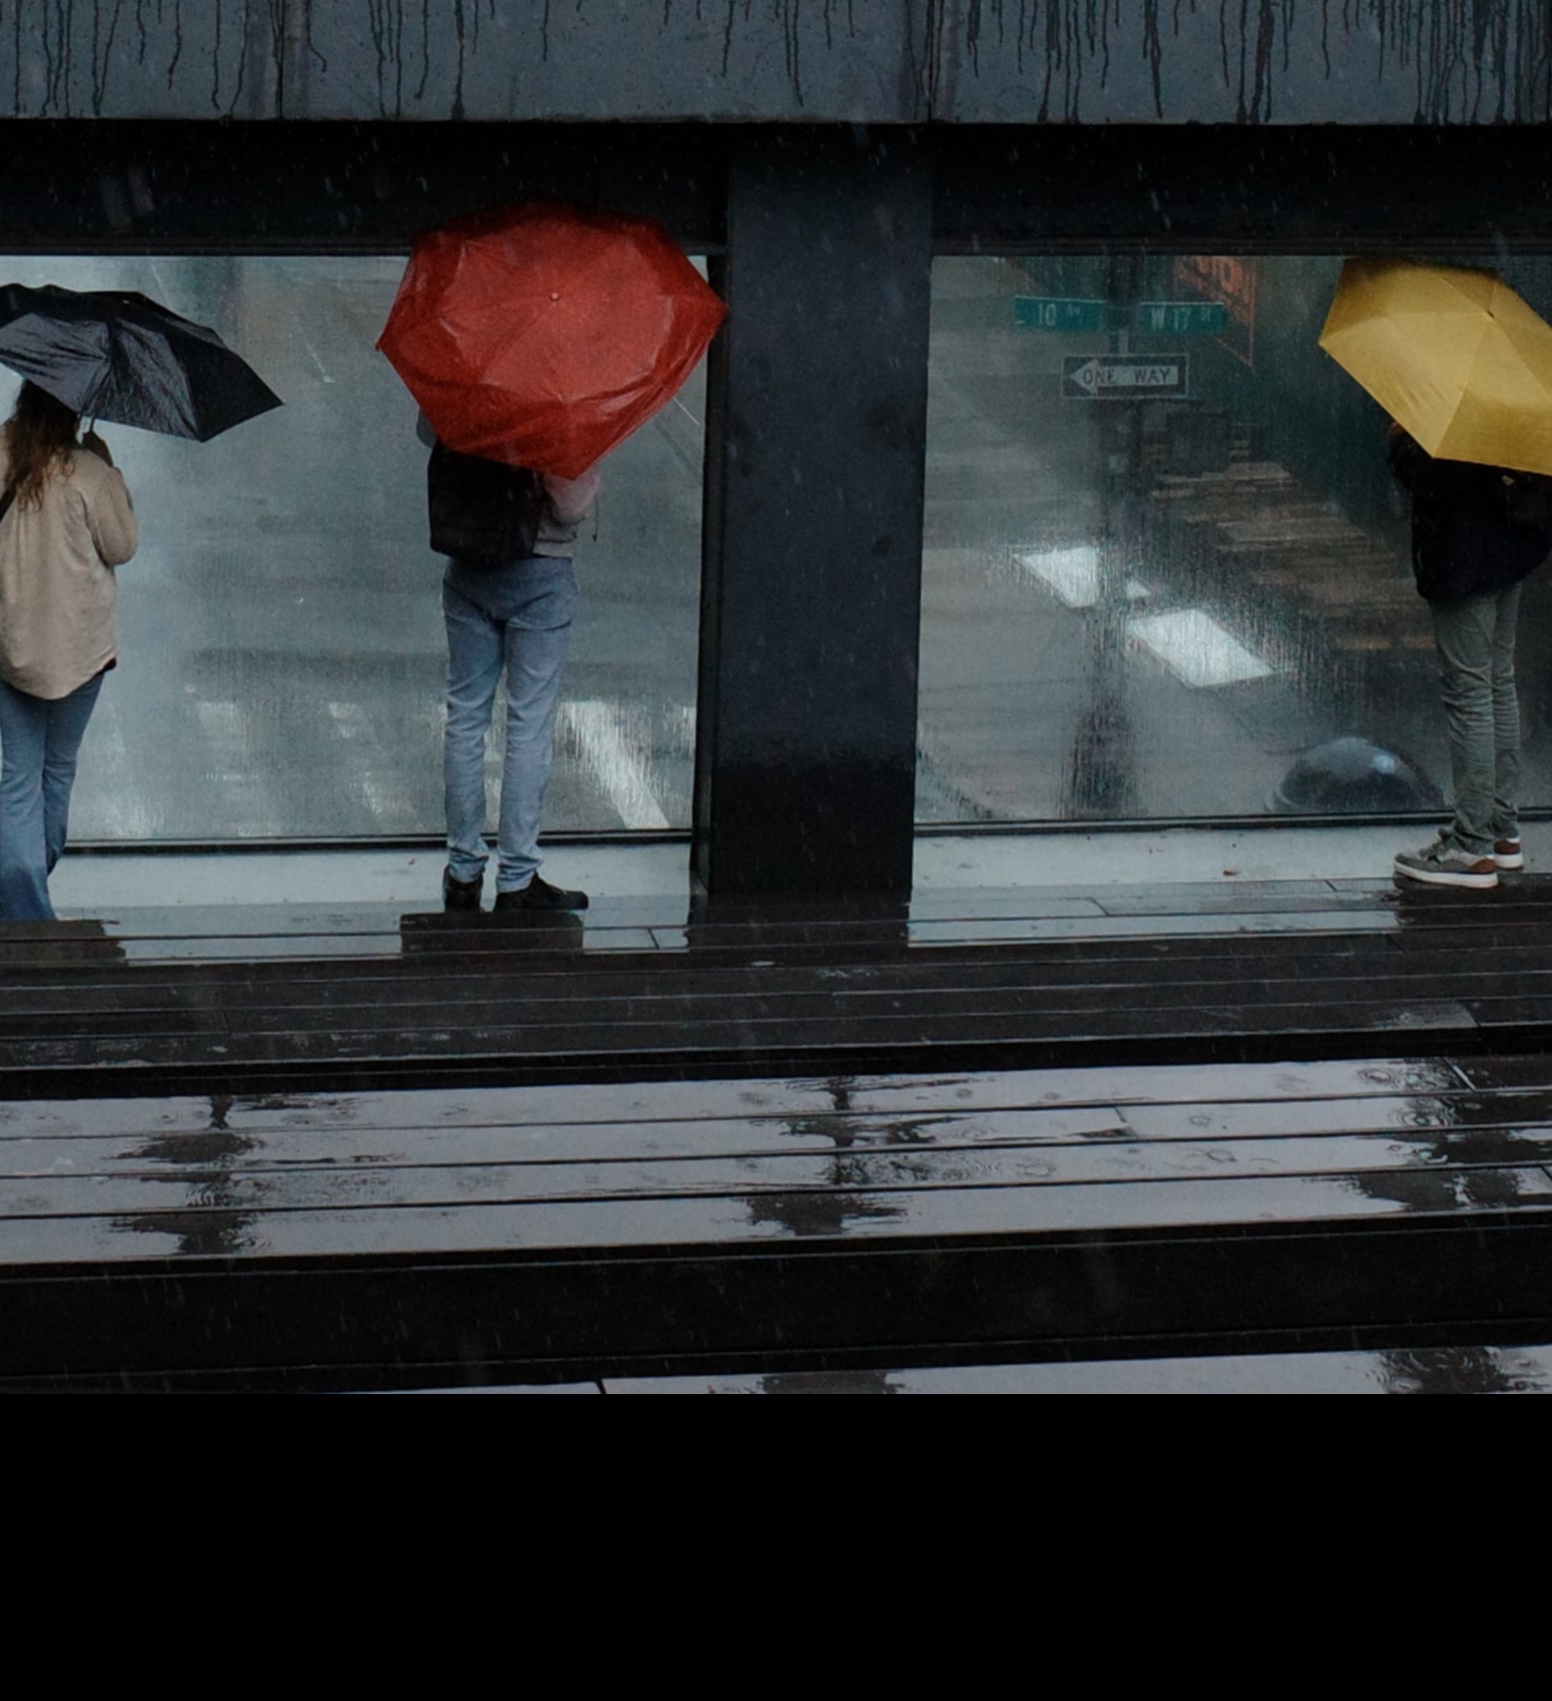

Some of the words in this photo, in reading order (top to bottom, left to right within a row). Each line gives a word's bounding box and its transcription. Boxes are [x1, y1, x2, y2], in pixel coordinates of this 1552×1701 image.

[1037, 302, 1057, 327] 10
[1151, 304, 1166, 331] W
[1173, 307, 1191, 332] 17
[1082, 367, 1117, 385] ONE
[1134, 366, 1171, 385] WAY
